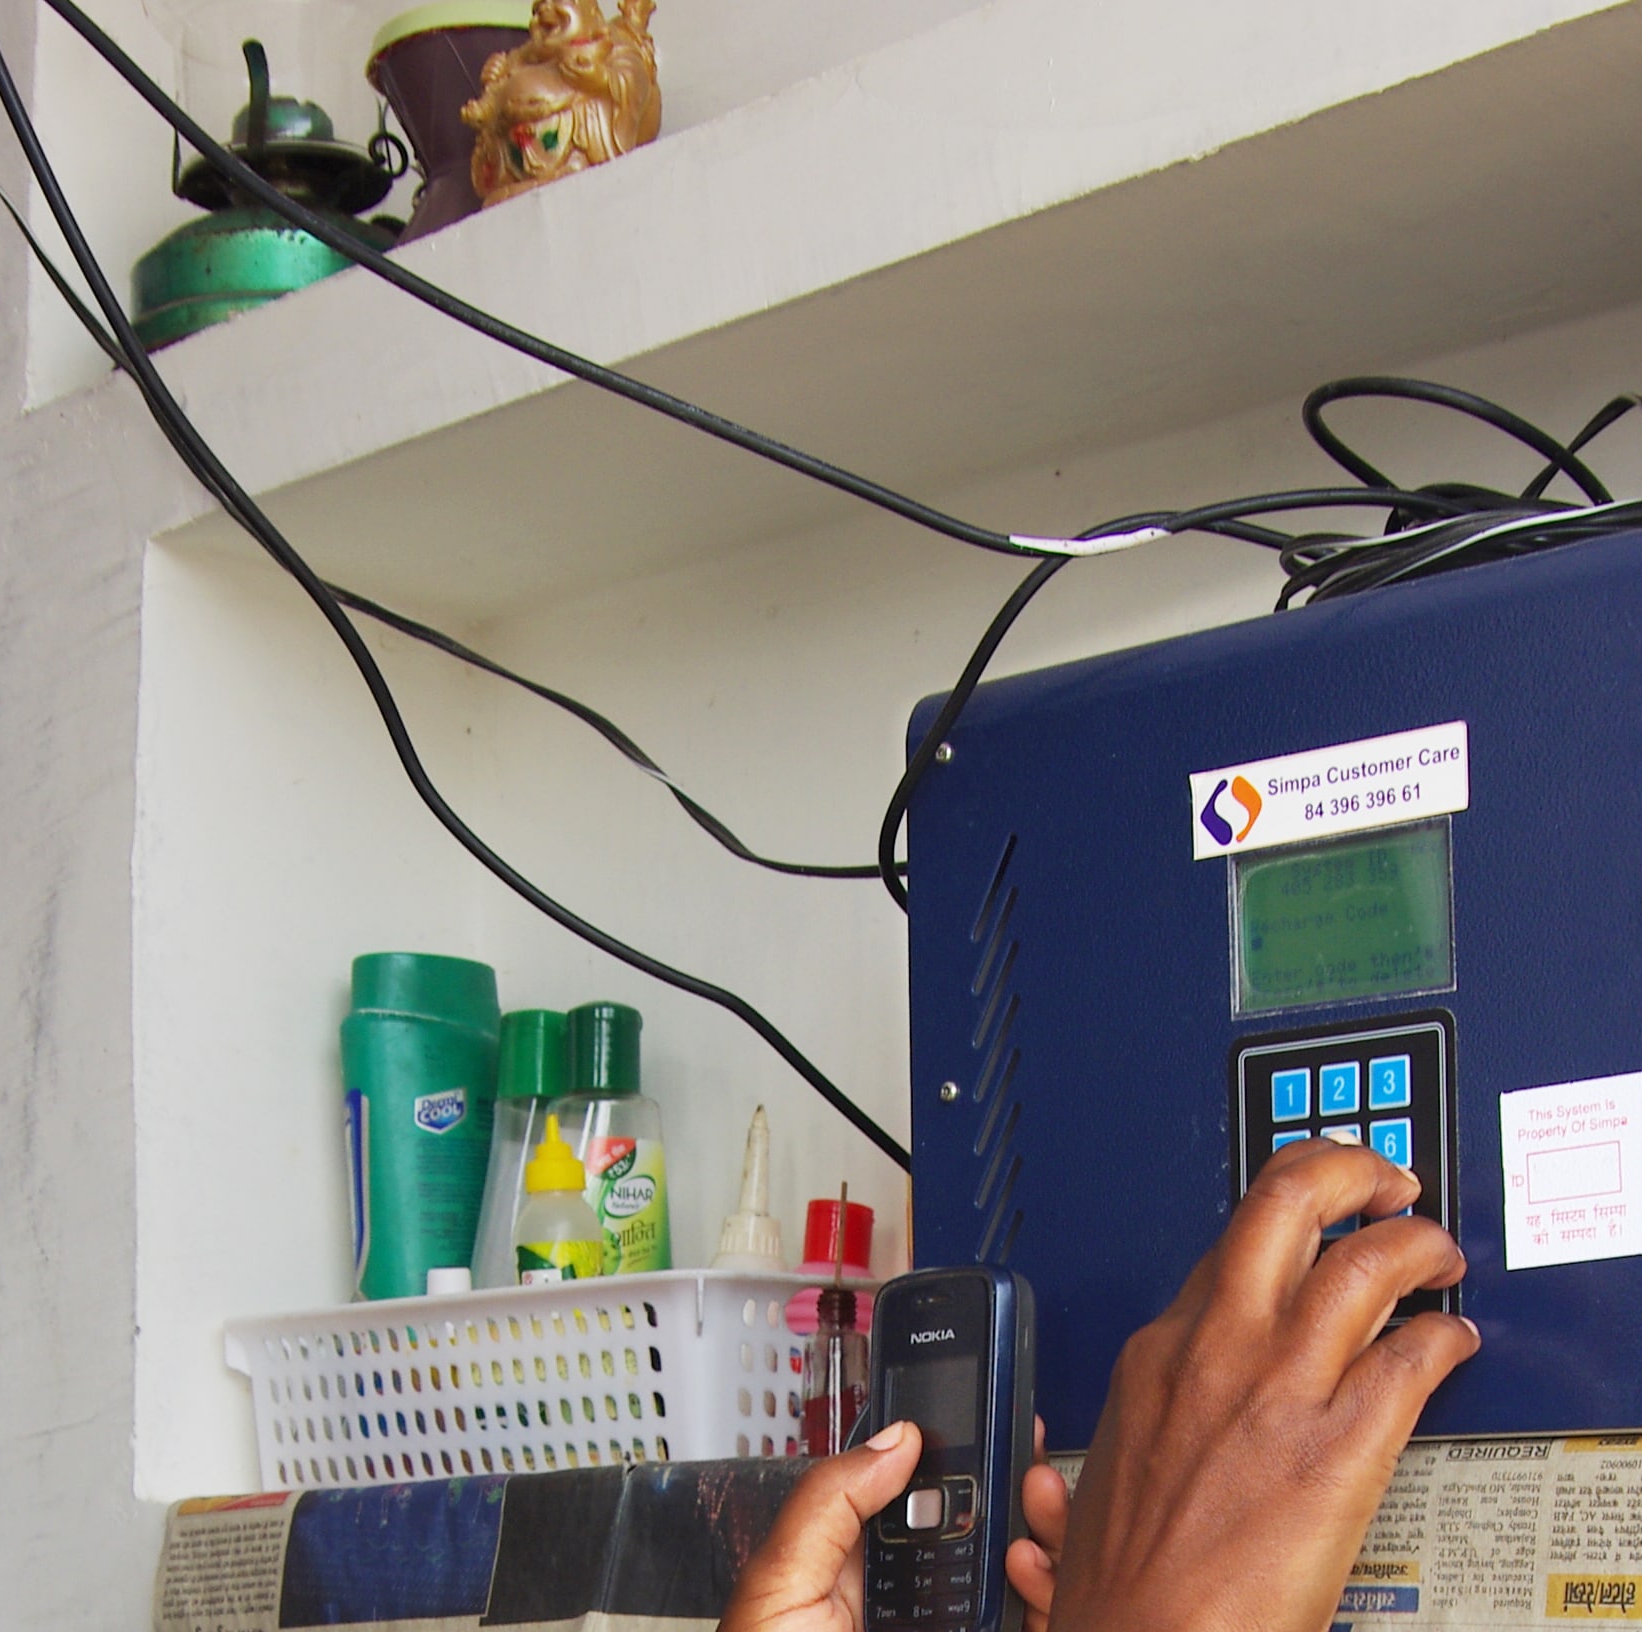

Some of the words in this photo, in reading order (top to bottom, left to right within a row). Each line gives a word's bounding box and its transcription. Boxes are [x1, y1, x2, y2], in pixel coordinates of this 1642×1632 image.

[1268, 772, 1321, 796] Simpa
[1327, 753, 1412, 785] Customer
[1418, 745, 1460, 766] Care
[1305, 803, 1324, 821] 84
[1330, 795, 1360, 816] 396
[1366, 788, 1396, 809] 396
[1402, 783, 1421, 802] 61
[1286, 1084, 1294, 1106] 1
[1334, 1077, 1346, 1101] 2
[1383, 1071, 1395, 1094] 3
[420, 1103, 461, 1123] COOL
[1529, 1109, 1553, 1121] This
[1557, 1102, 1601, 1119] System
[1606, 1099, 1616, 1110] Is
[1518, 1126, 1567, 1142] Property
[1572, 1121, 1585, 1133] Of
[1590, 1117, 1628, 1131] Simpa
[1384, 1133, 1397, 1156] 6
[1512, 1175, 1524, 1187] ID
[611, 1187, 653, 1202] NIHAR
[1526, 1215, 1541, 1227] यह
[910, 1328, 955, 1344] NOKIA
[1449, 1445, 1548, 1459] REQUIRED
[1480, 1496, 1498, 1505] near
[1437, 1507, 1472, 1519] Dholpur
[1554, 1512, 1574, 1520] F&B
[1509, 1520, 1536, 1532] Trendy
[1495, 1533, 1536, 1546] Rajasthan
[1491, 1548, 1500, 1558] of
[1516, 1547, 1535, 1558] edge
[1468, 1558, 1494, 1570] having
[1473, 1574, 1484, 1583] for
[1492, 1574, 1533, 1584] Executive
[1493, 1598, 1531, 1610] Required
